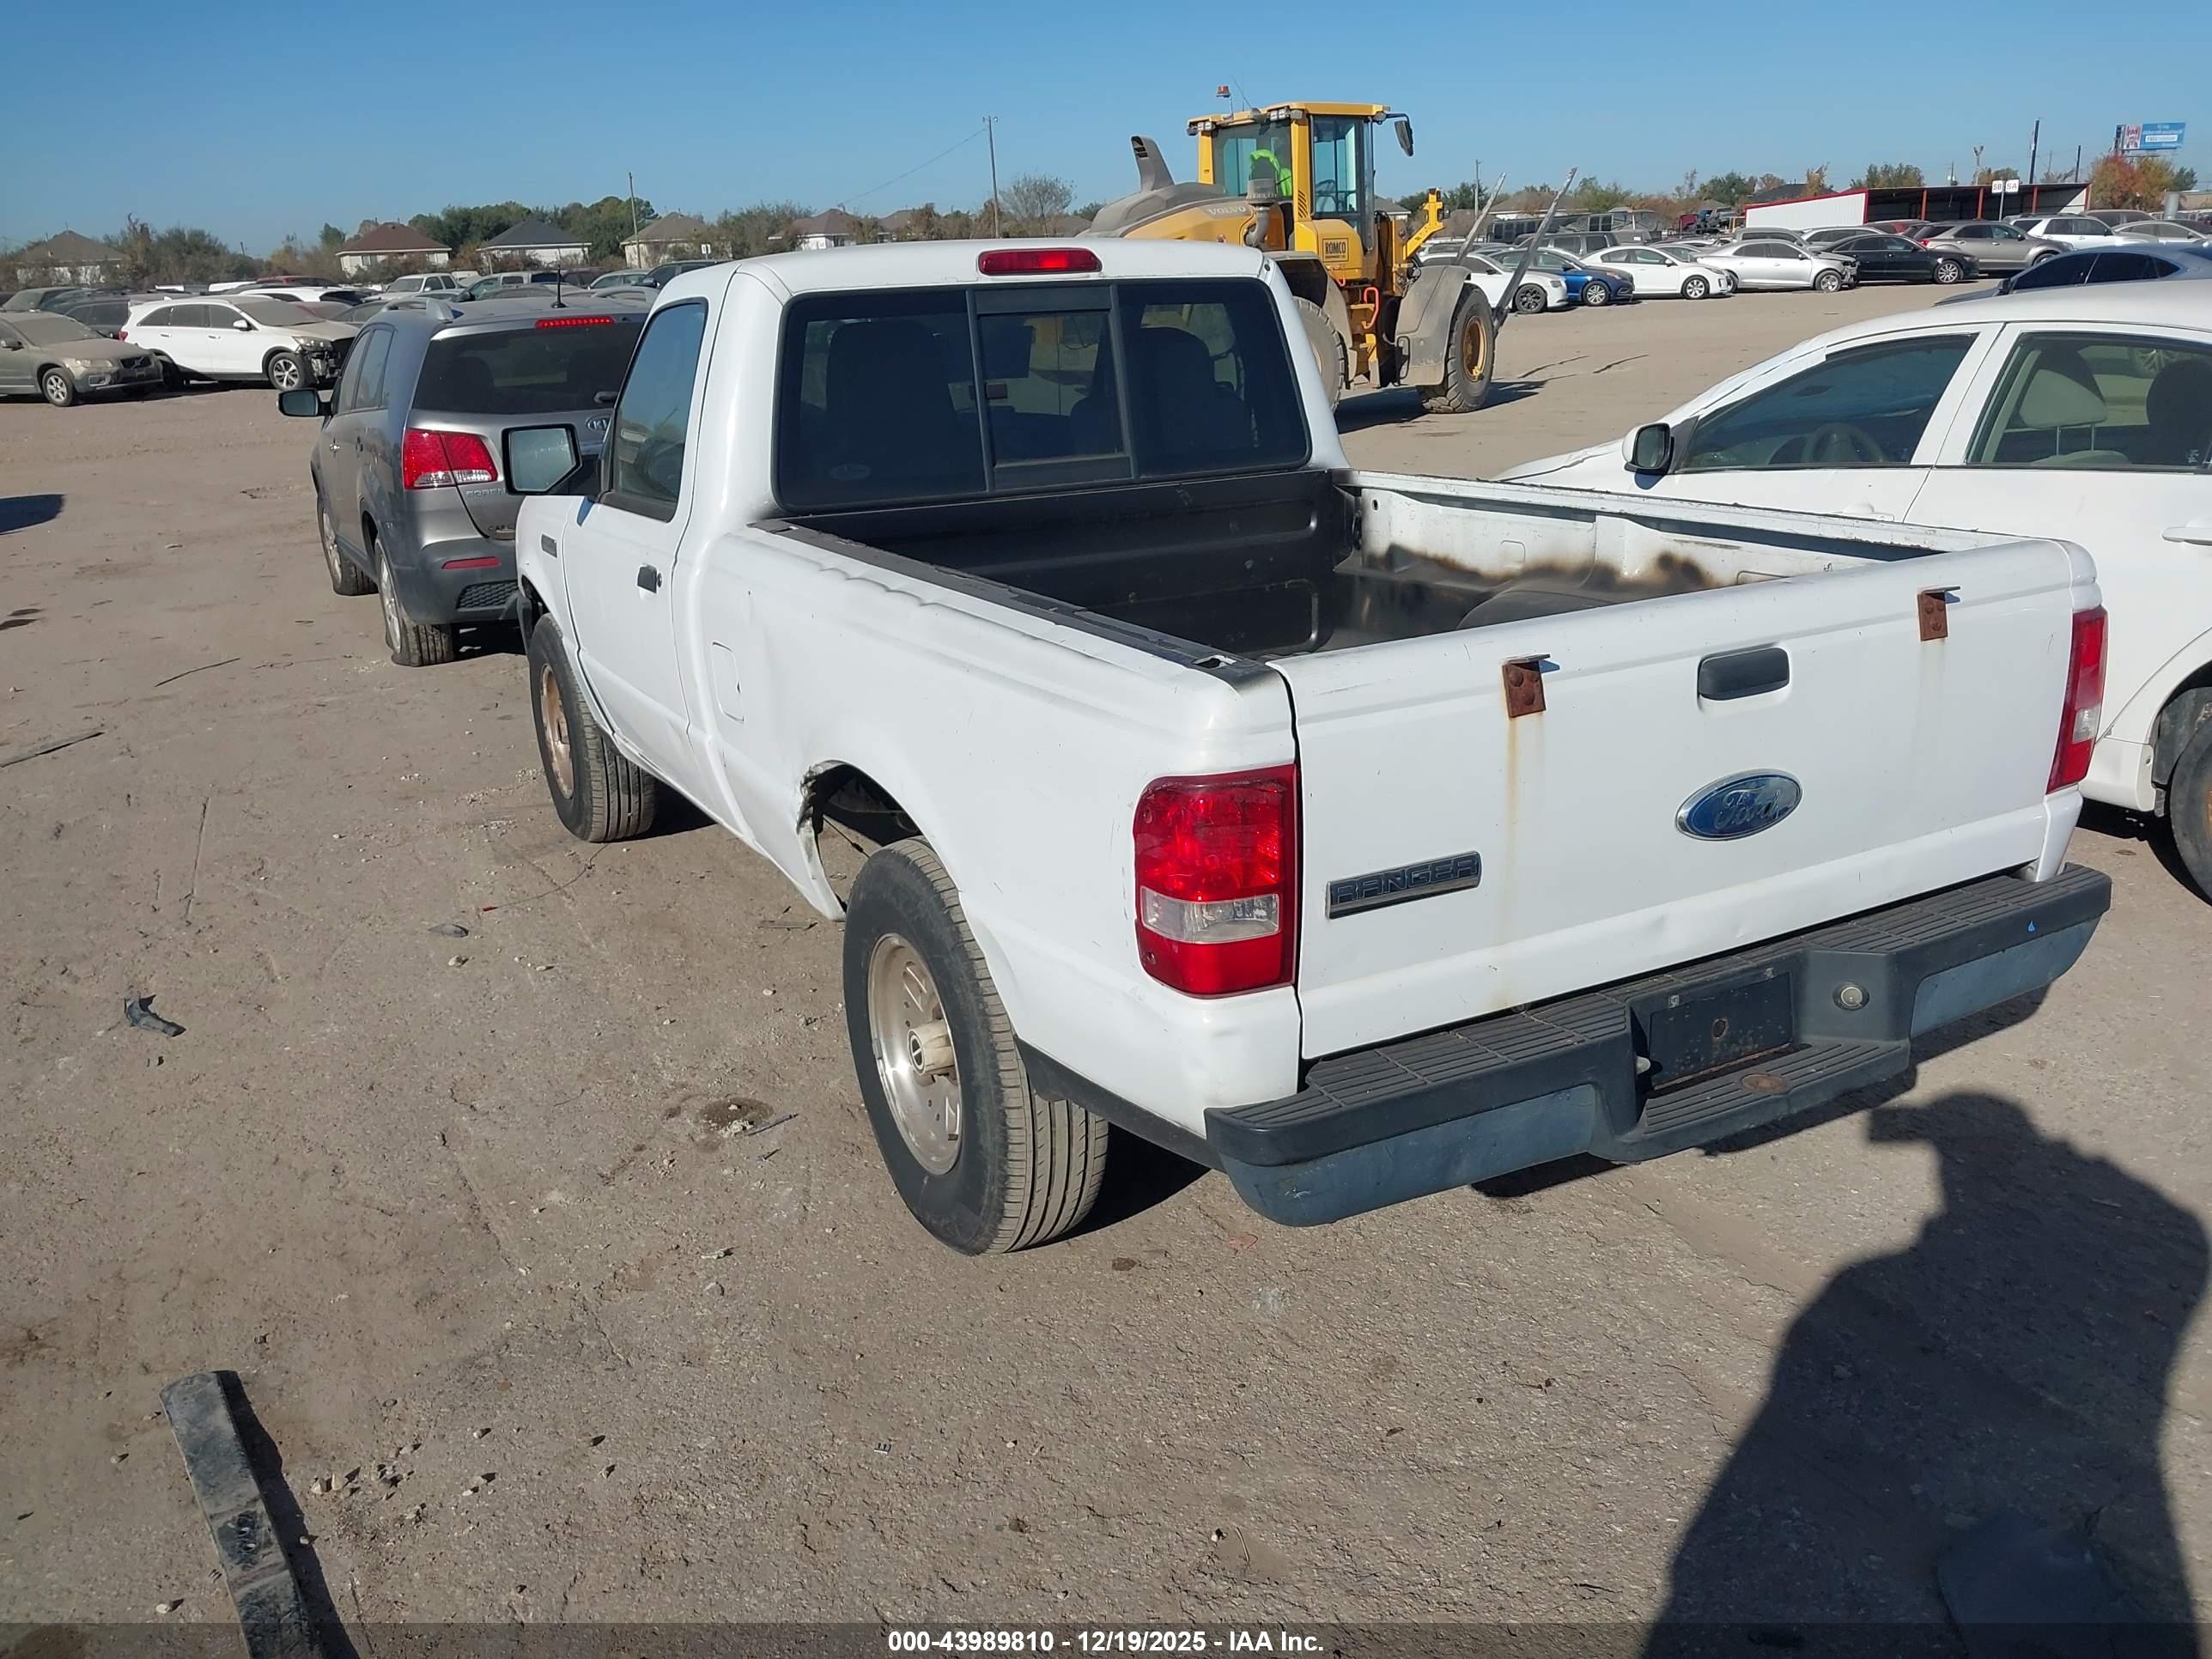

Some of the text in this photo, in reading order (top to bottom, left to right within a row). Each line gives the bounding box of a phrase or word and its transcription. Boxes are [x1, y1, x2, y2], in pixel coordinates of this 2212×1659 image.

[2006, 182, 2017, 191] SA
[1208, 206, 1247, 215] VOLVO
[1325, 241, 1346, 255] ROMCO
[1713, 785, 1781, 830] Ford
[1331, 856, 1480, 905] RANGER
